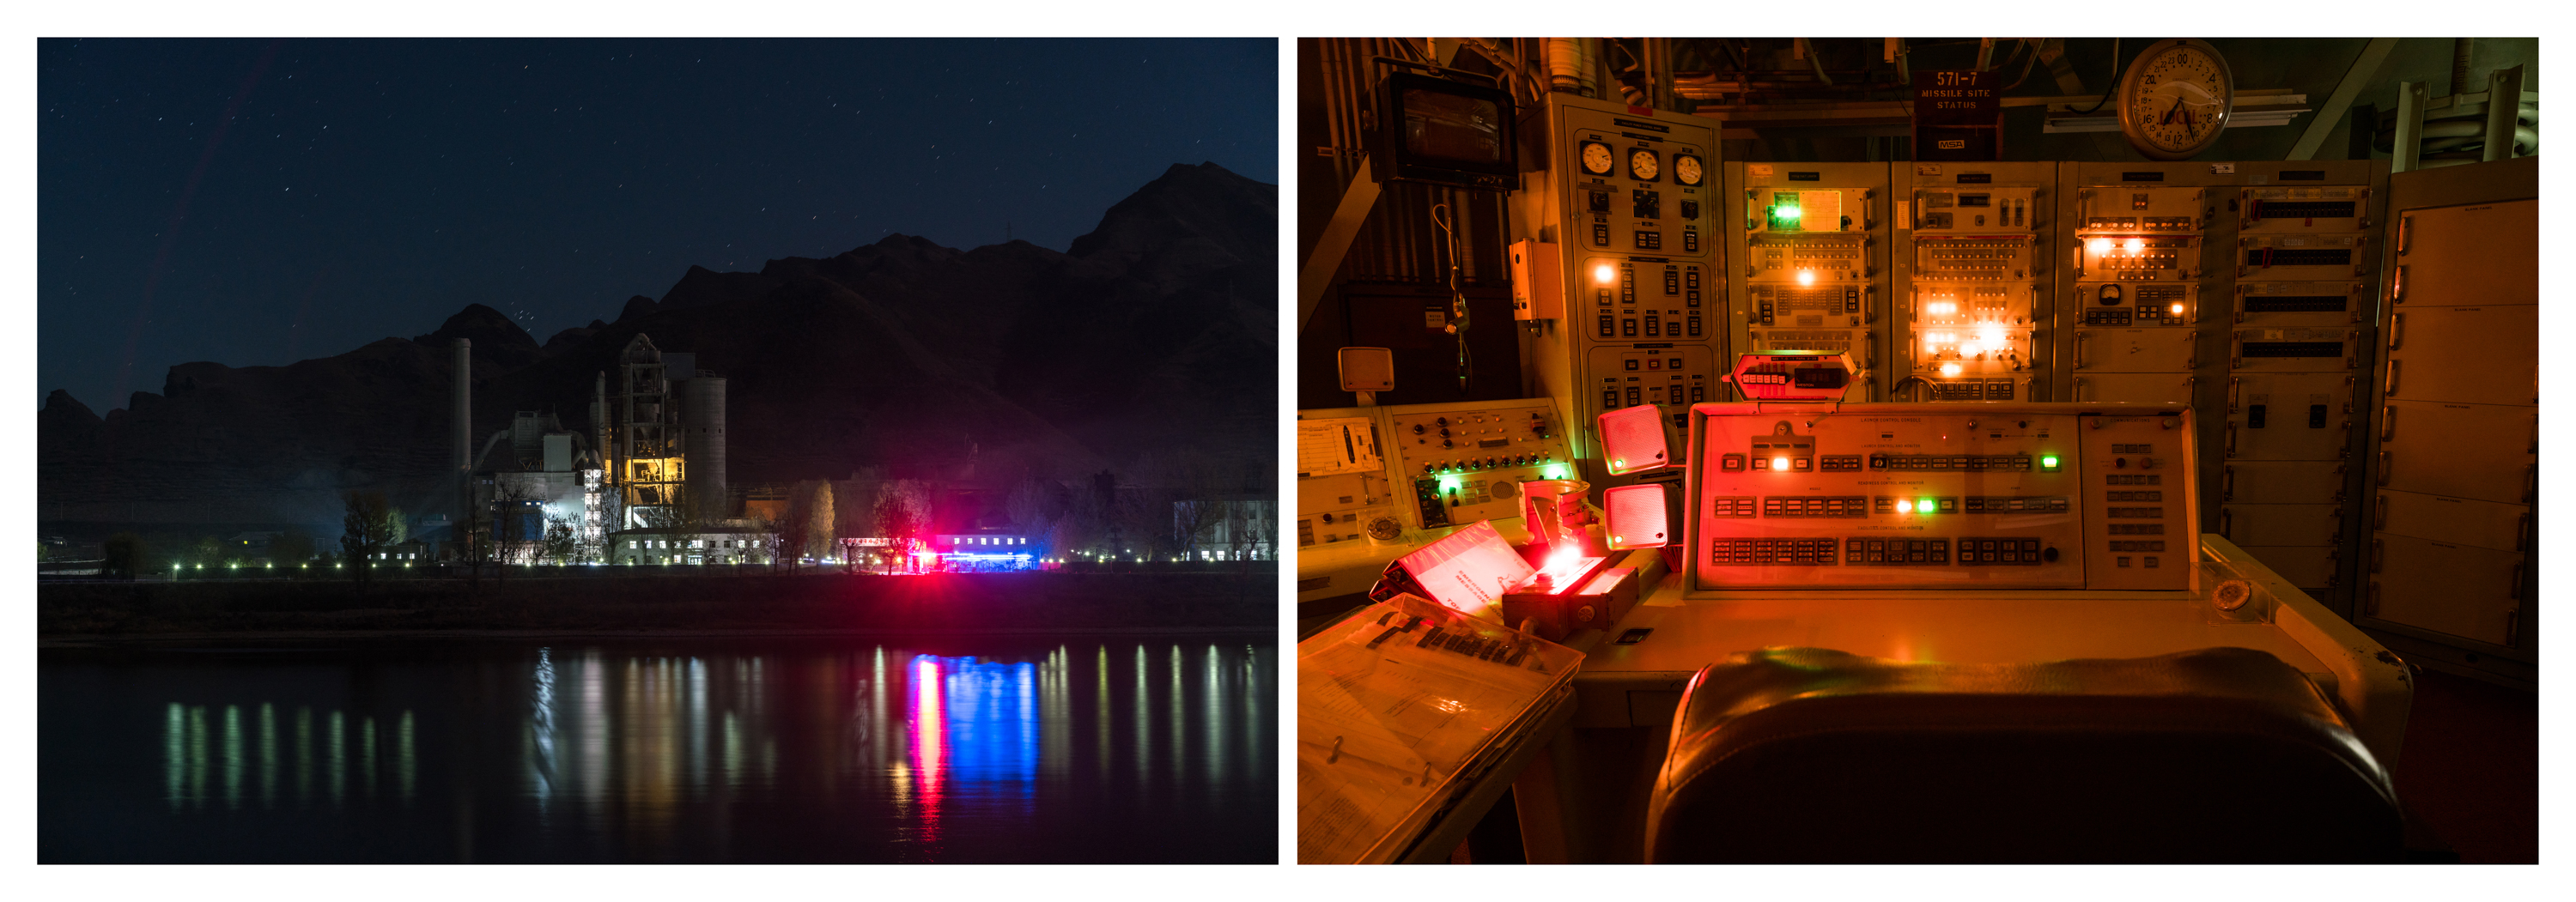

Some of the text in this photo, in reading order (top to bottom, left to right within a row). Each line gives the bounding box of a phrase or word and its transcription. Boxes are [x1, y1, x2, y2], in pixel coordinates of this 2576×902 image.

[2177, 54, 2187, 64] 00
[1937, 72, 1977, 86] 571-7
[2145, 75, 2155, 84] 20
[2209, 74, 2216, 82] 4
[2144, 115, 2152, 123] 16
[2160, 110, 2197, 125] LOCAL
[2207, 113, 2213, 123] 8
[2174, 135, 2182, 145] 12
[1514, 558, 1526, 569] TOP
[1455, 575, 1486, 604] MESSAGE
[1459, 570, 1494, 602] EMERGENC
